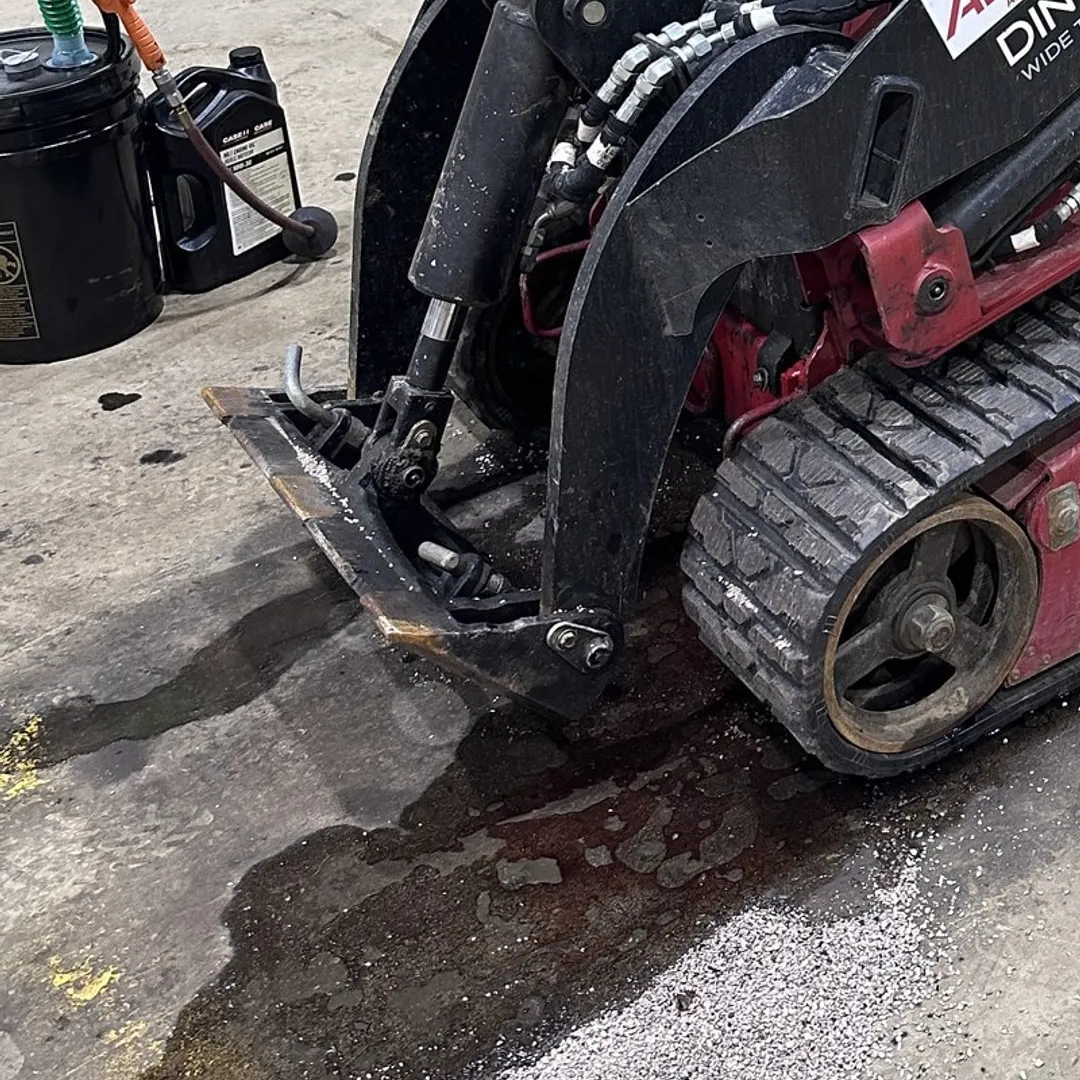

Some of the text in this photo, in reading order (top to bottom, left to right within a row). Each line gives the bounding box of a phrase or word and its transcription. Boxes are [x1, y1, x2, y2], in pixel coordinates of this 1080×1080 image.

[1021, 29, 1074, 81] WIDE
[253, 119, 273, 132] CASE
[222, 131, 243, 144] CASE
